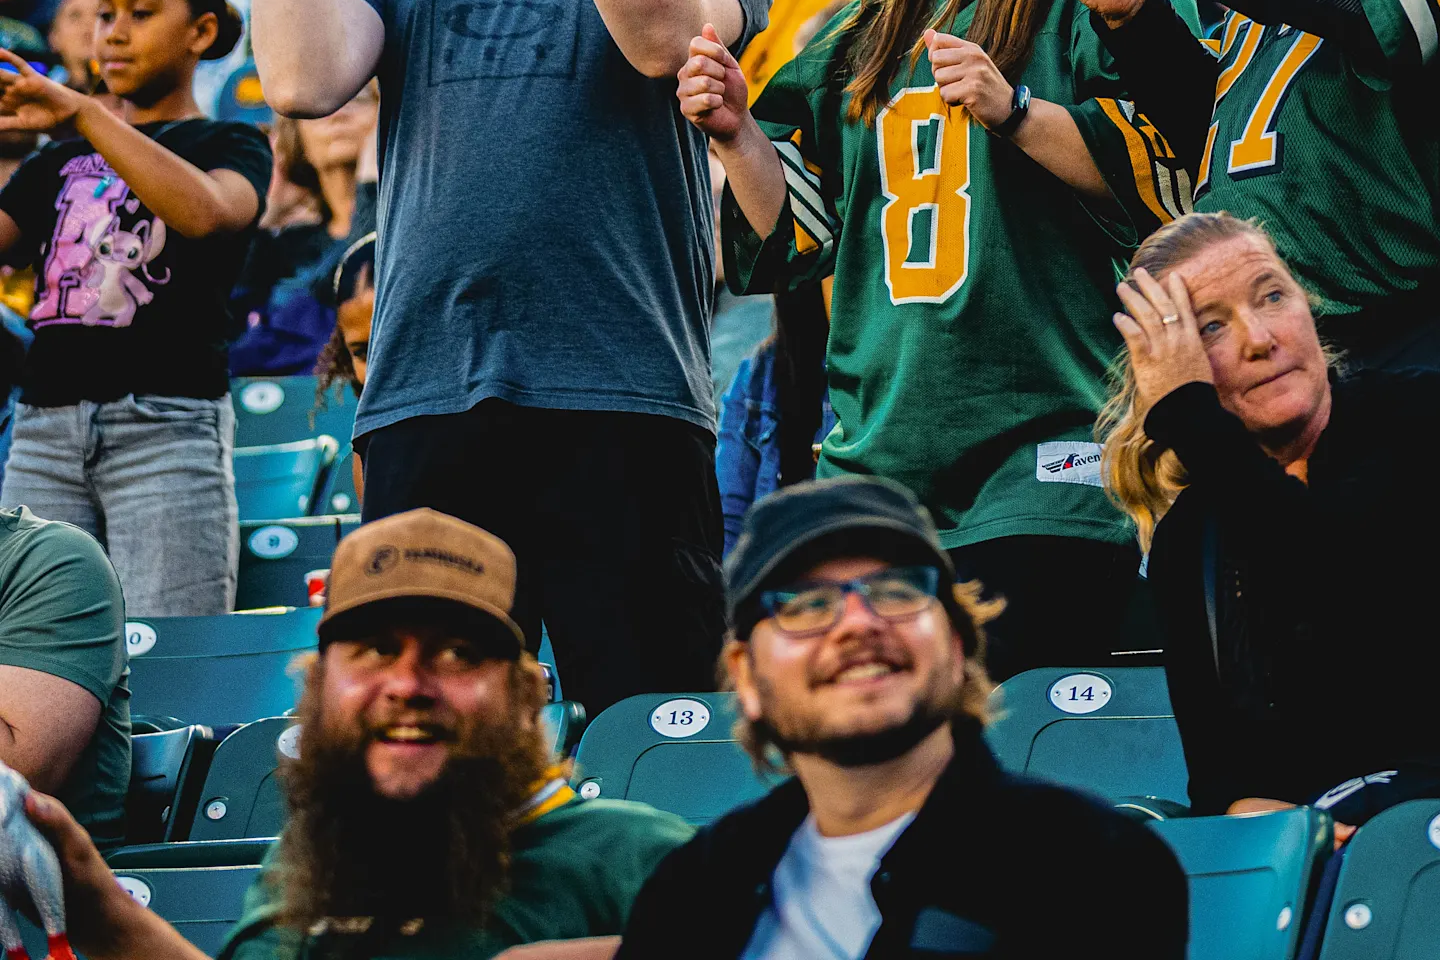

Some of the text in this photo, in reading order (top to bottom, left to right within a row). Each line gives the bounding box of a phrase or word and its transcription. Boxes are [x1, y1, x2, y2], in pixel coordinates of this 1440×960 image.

[876, 83, 971, 306] 8
[1068, 686, 1095, 701] 14
[667, 710, 694, 726] 13
